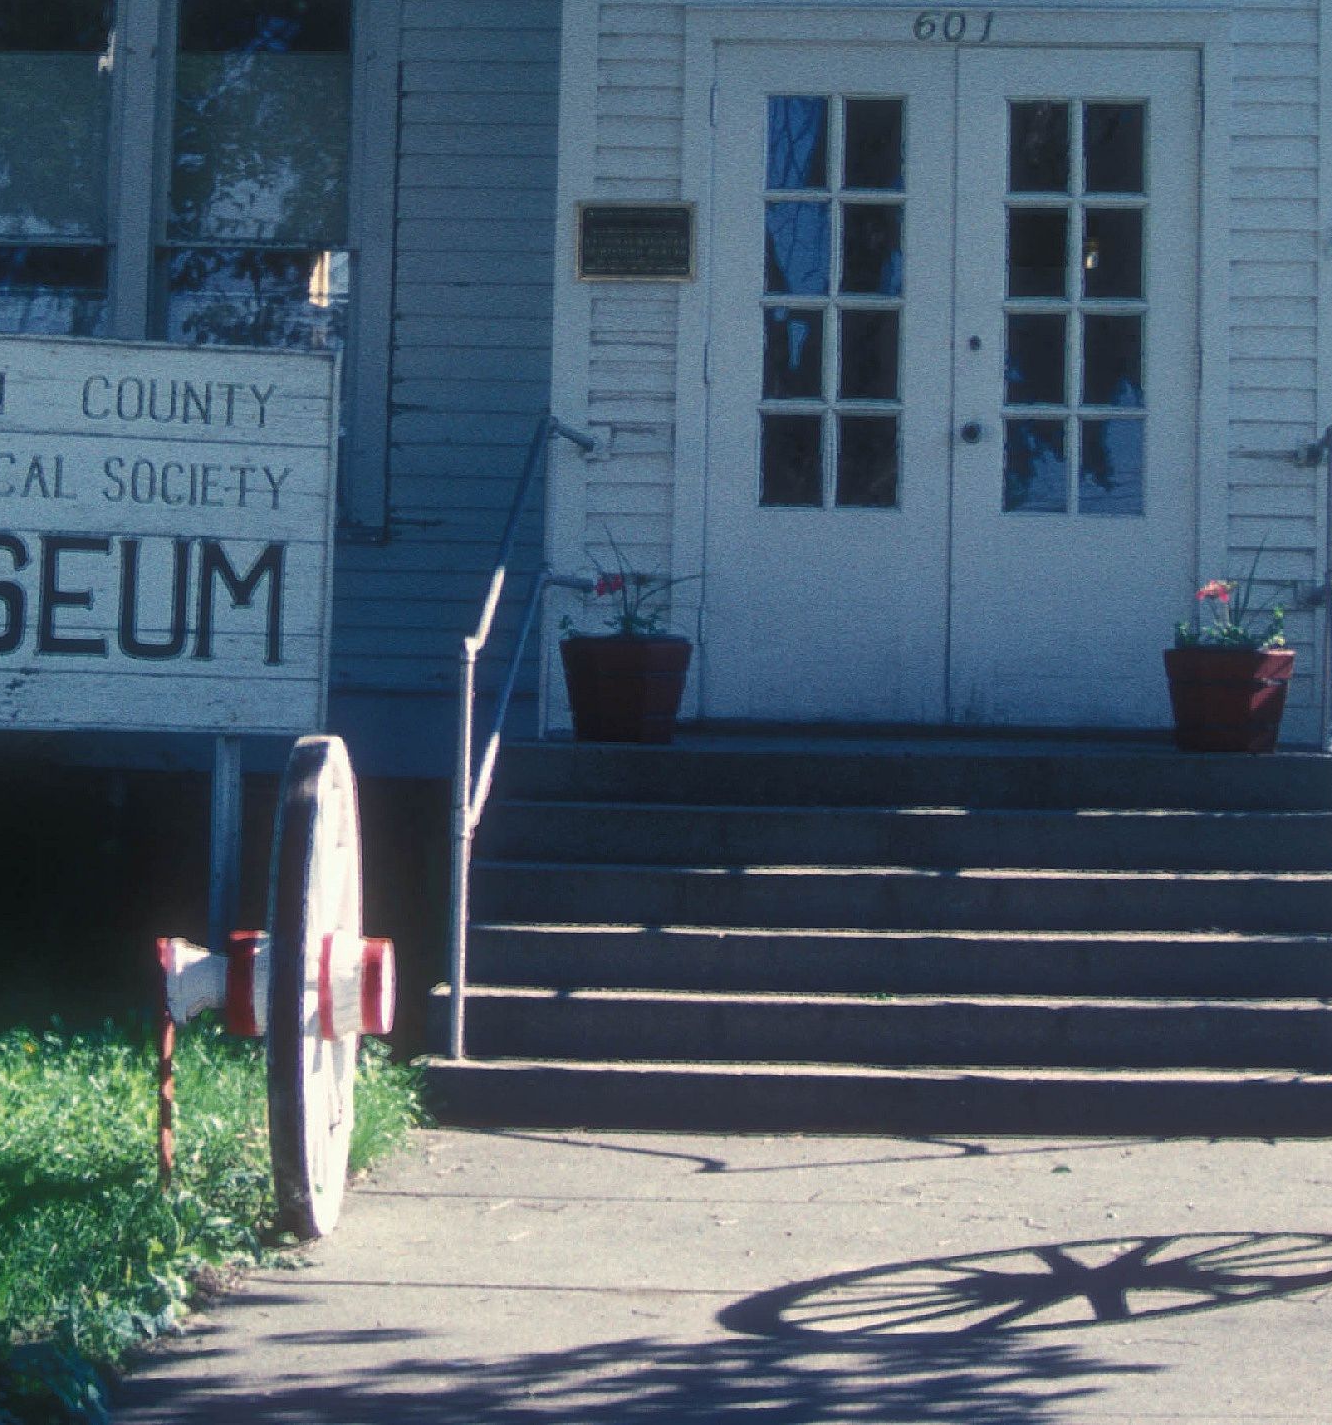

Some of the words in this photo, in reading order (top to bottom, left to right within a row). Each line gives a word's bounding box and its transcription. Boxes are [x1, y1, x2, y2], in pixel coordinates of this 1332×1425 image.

[912, 10, 995, 43] 601
[81, 374, 278, 429] COUNTY
[100, 455, 294, 511] SOCIETY
